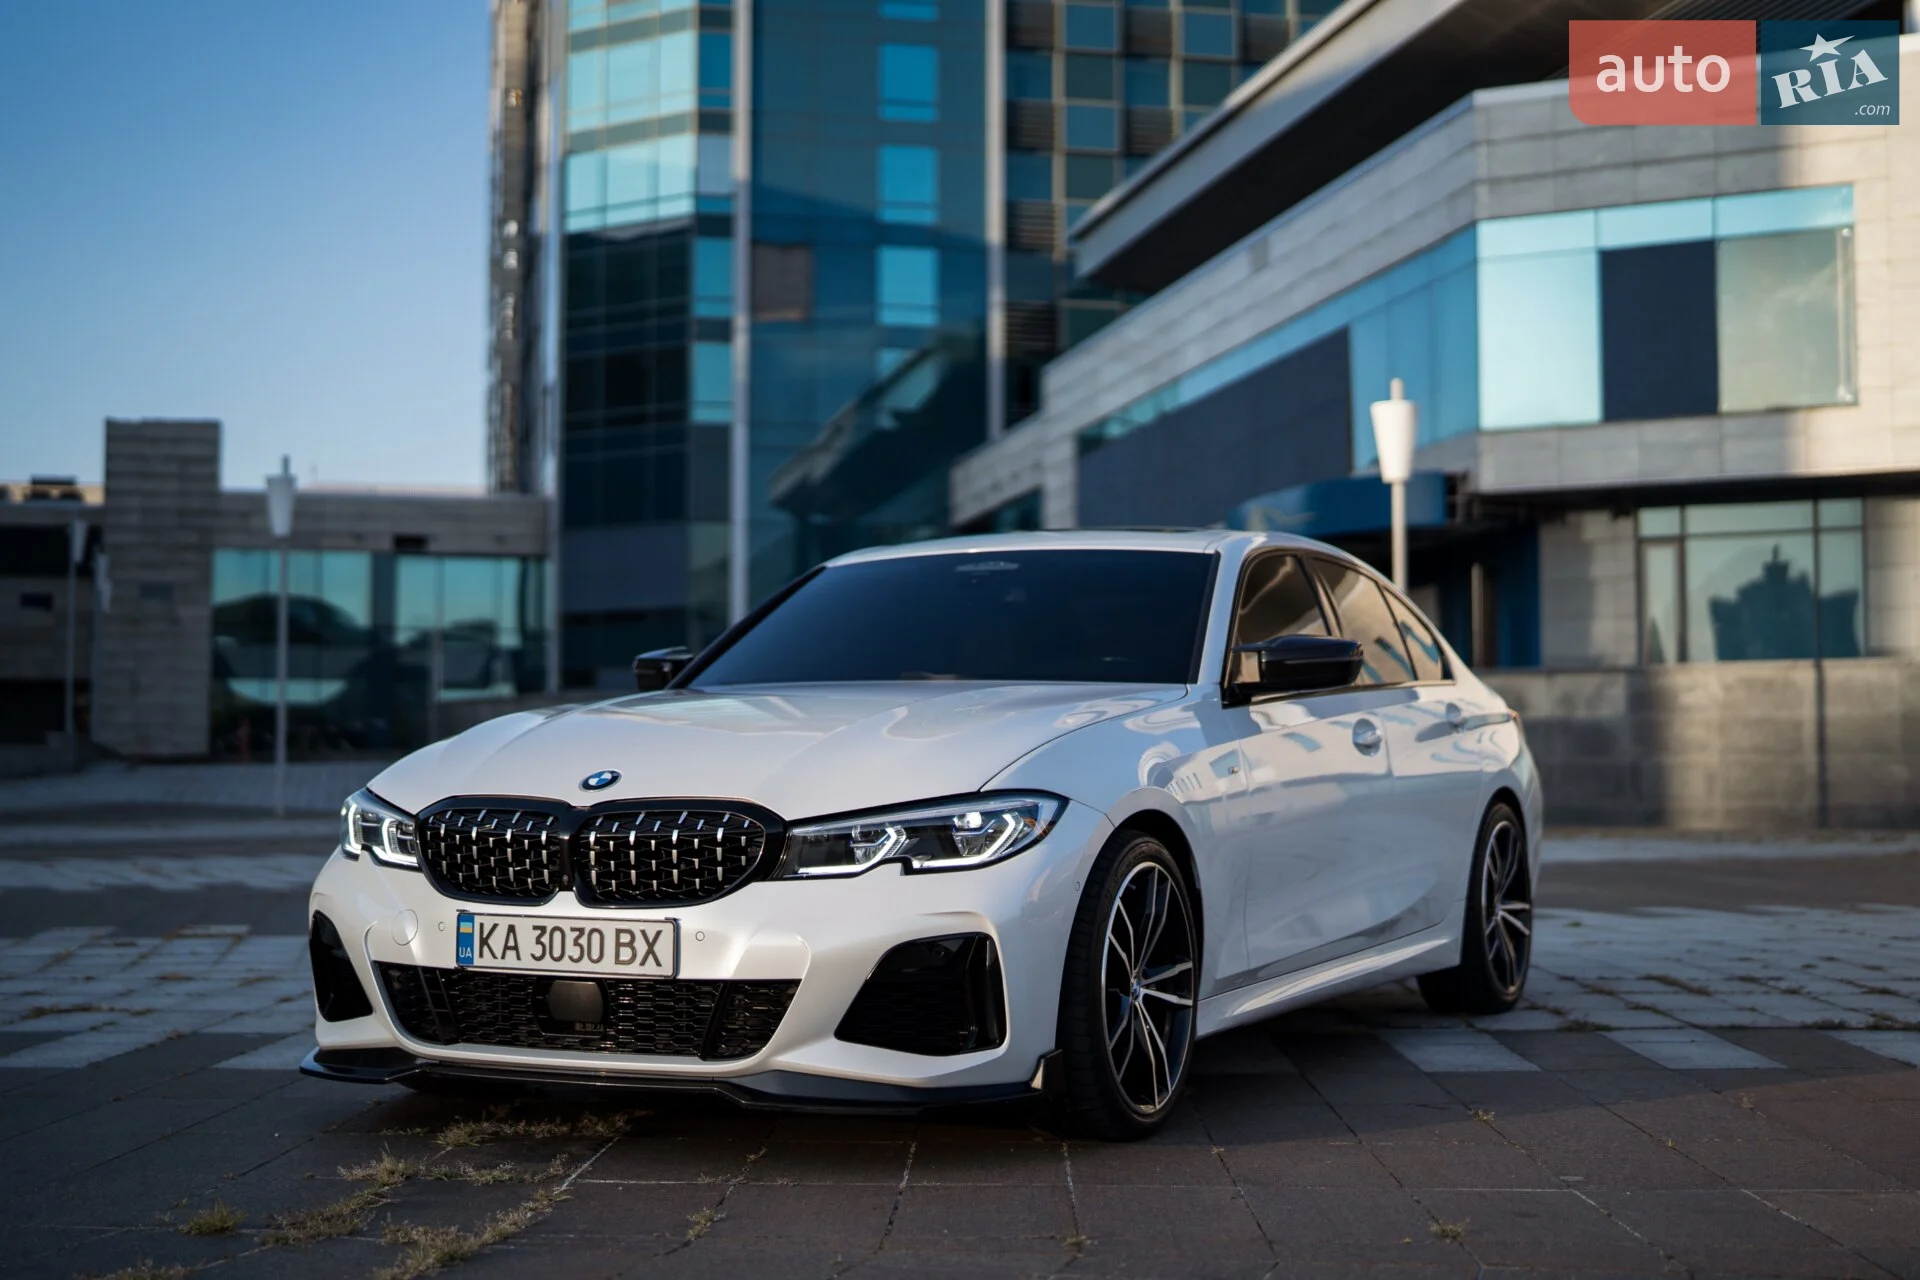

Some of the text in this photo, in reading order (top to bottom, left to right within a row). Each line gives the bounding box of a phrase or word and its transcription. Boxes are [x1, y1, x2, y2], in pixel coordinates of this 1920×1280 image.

[459, 946, 473, 958] UA
[478, 922, 663, 967] KA 3030 BX
